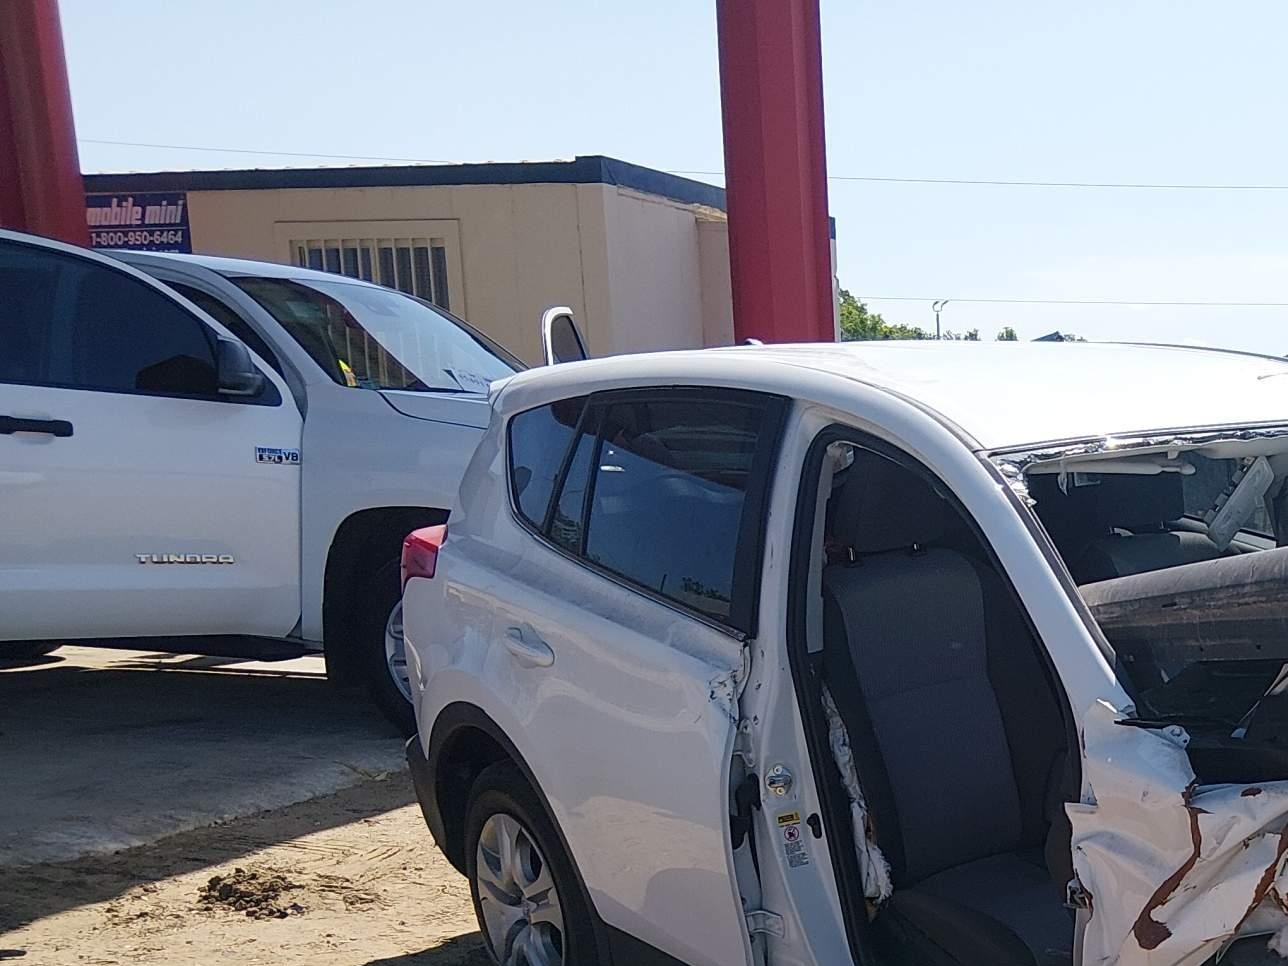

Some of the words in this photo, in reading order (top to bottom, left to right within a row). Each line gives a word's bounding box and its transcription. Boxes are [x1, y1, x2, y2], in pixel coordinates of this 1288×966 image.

[87, 197, 142, 225] mobile
[145, 200, 184, 224] mini
[91, 231, 182, 245] 1-800-950-6464
[283, 451, 299, 462] V8
[136, 554, 234, 564] TUNDRA
